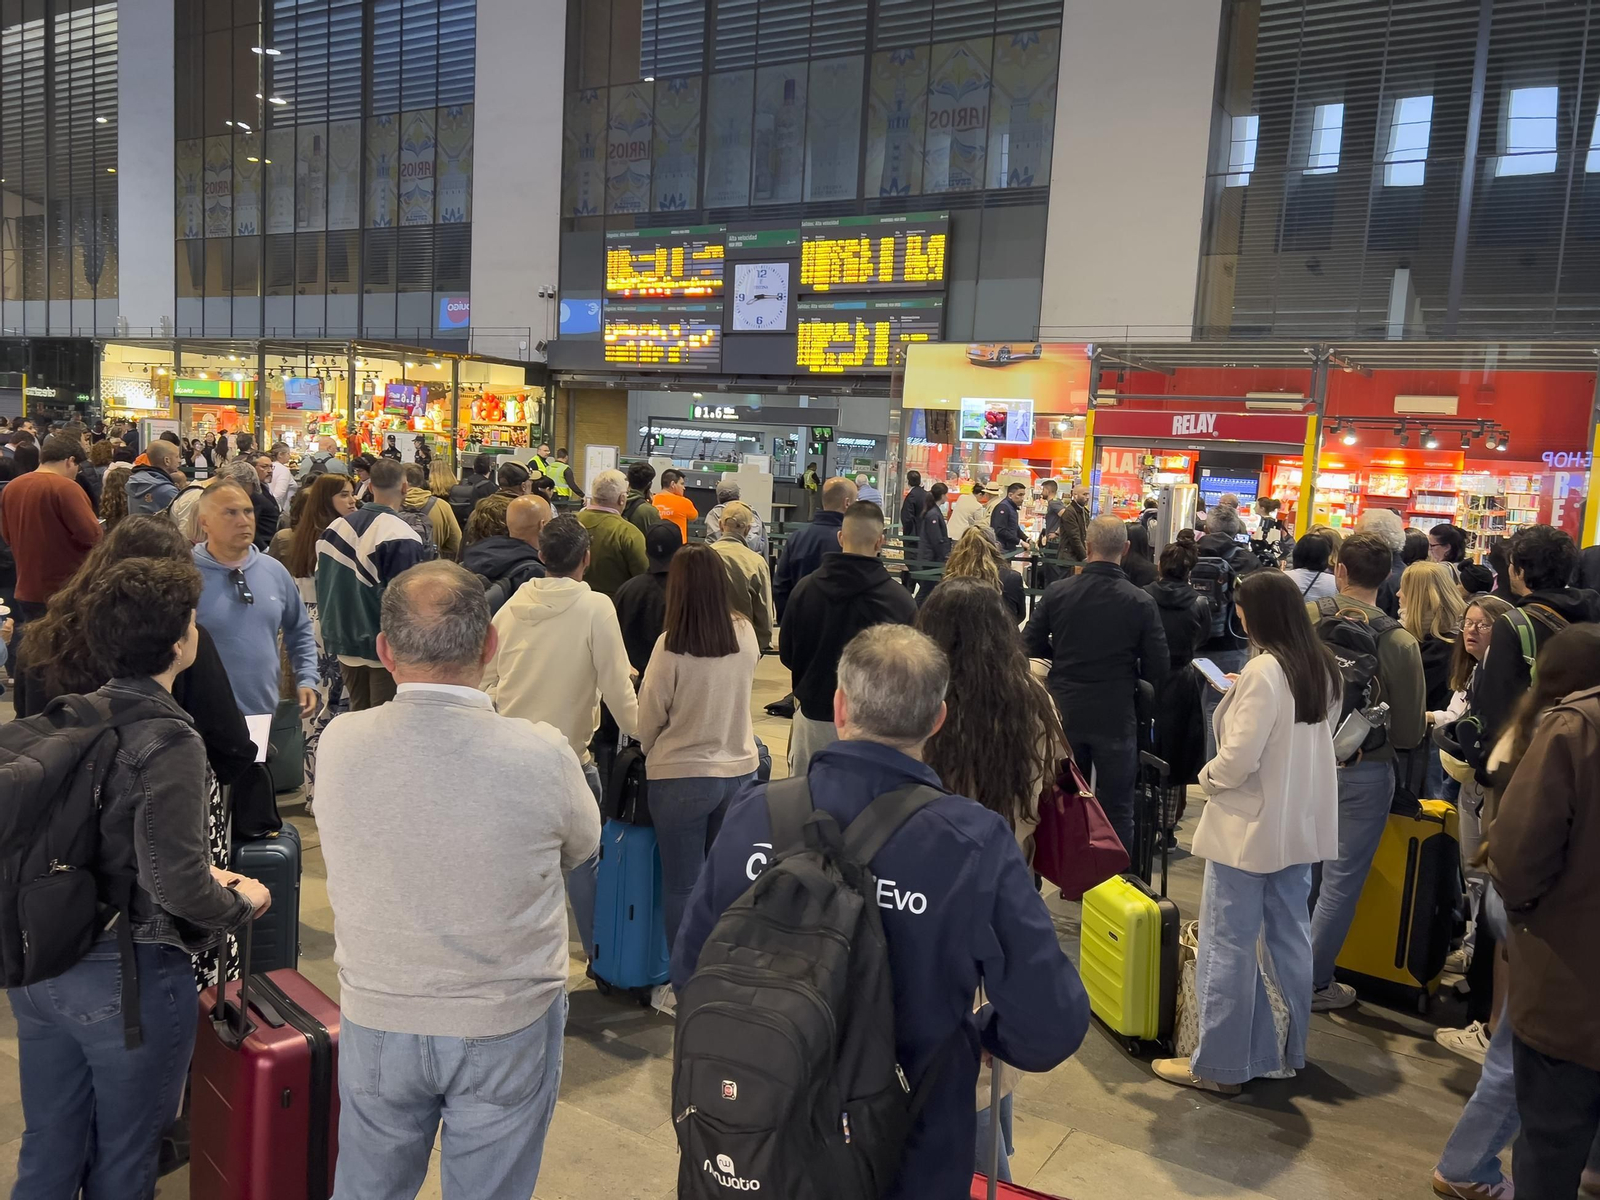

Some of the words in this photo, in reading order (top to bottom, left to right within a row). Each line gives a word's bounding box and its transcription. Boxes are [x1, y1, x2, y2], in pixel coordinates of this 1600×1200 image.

[756, 269, 767, 278] 12
[738, 293, 745, 301] 9
[776, 292, 783, 301] 3
[756, 316, 763, 325] 6
[1172, 414, 1217, 436] RELAY
